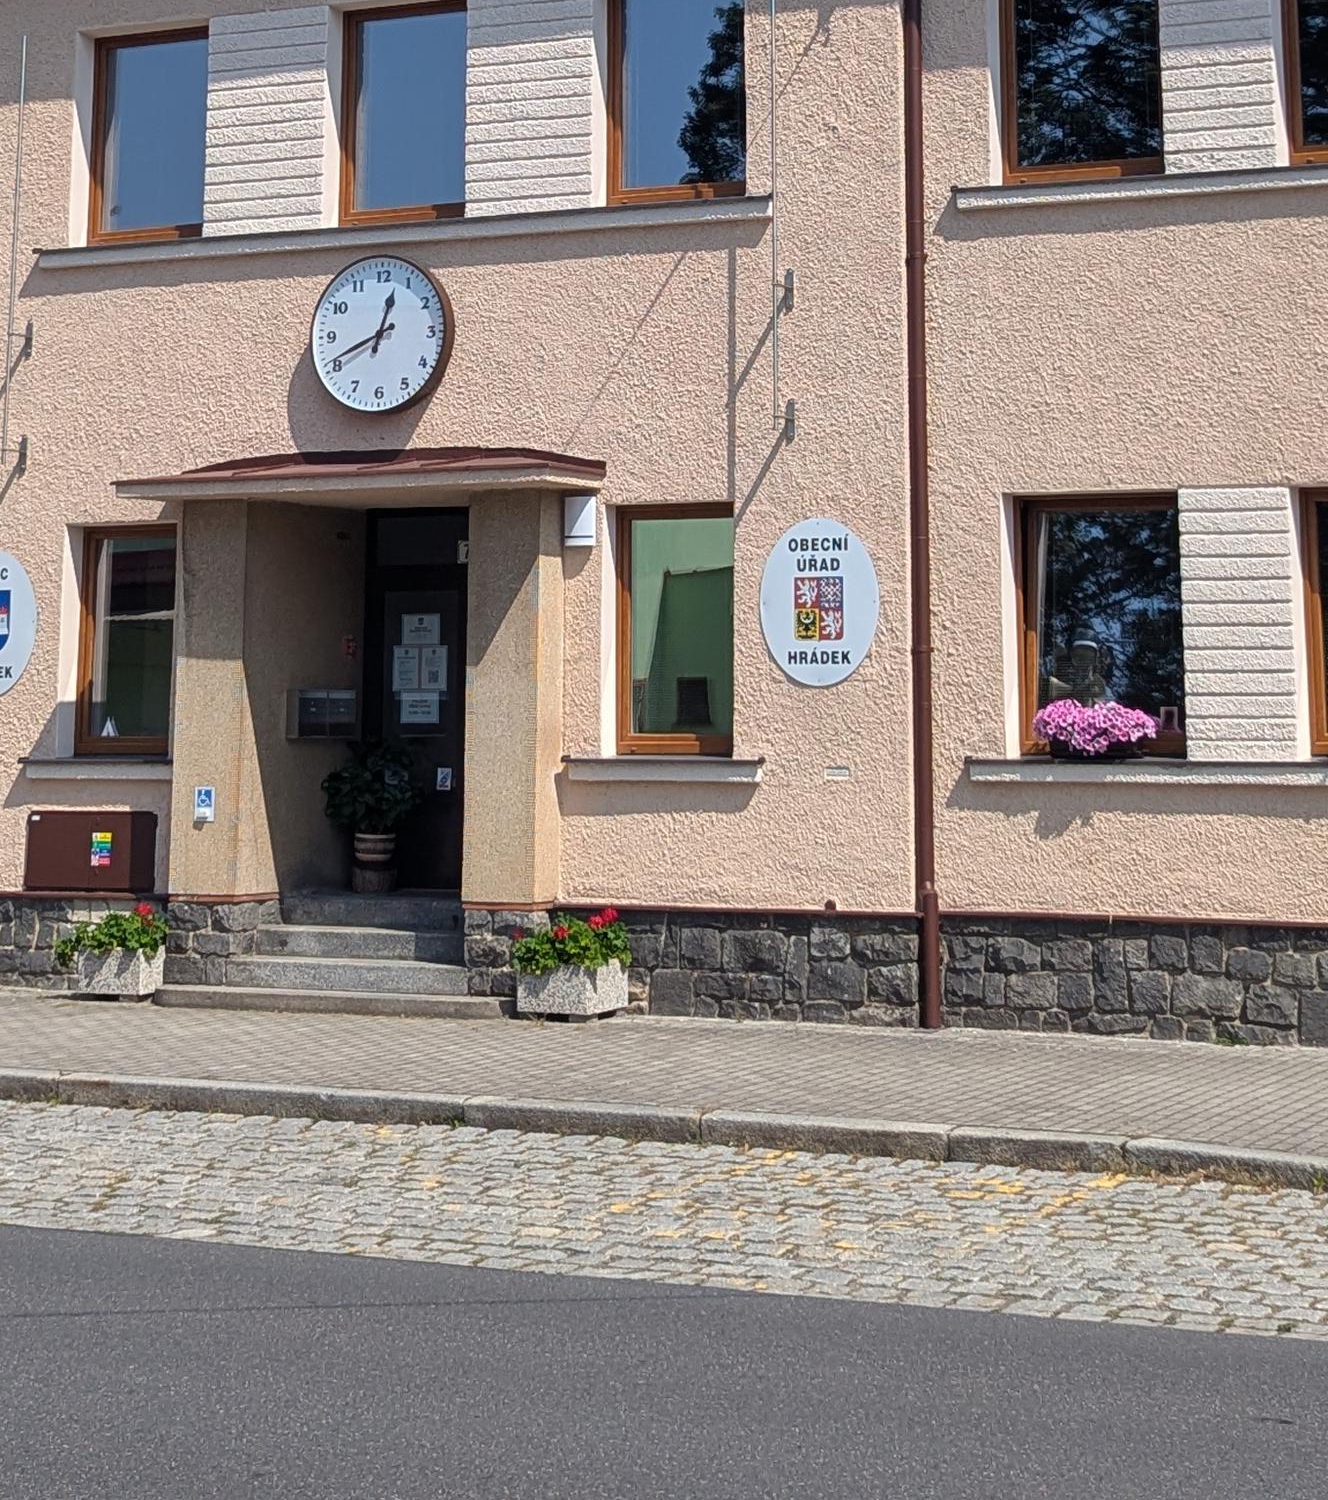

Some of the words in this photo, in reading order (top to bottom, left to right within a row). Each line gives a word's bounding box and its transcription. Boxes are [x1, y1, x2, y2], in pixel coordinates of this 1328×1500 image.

[376, 270, 392, 283] 12
[405, 277, 412, 289] 1
[352, 280, 364, 293] 11
[333, 301, 348, 315] 10
[420, 296, 430, 310] 2
[326, 331, 337, 344] 9
[426, 325, 436, 339] 3
[332, 359, 342, 372] 8
[418, 355, 428, 369] 4
[350, 380, 360, 393] 7
[400, 377, 409, 391] 5
[374, 386, 384, 399] 6
[788, 533, 849, 552] OBECNÍ
[797, 555, 840, 572] ÚŘAD
[788, 647, 852, 665] HRÁDEK
